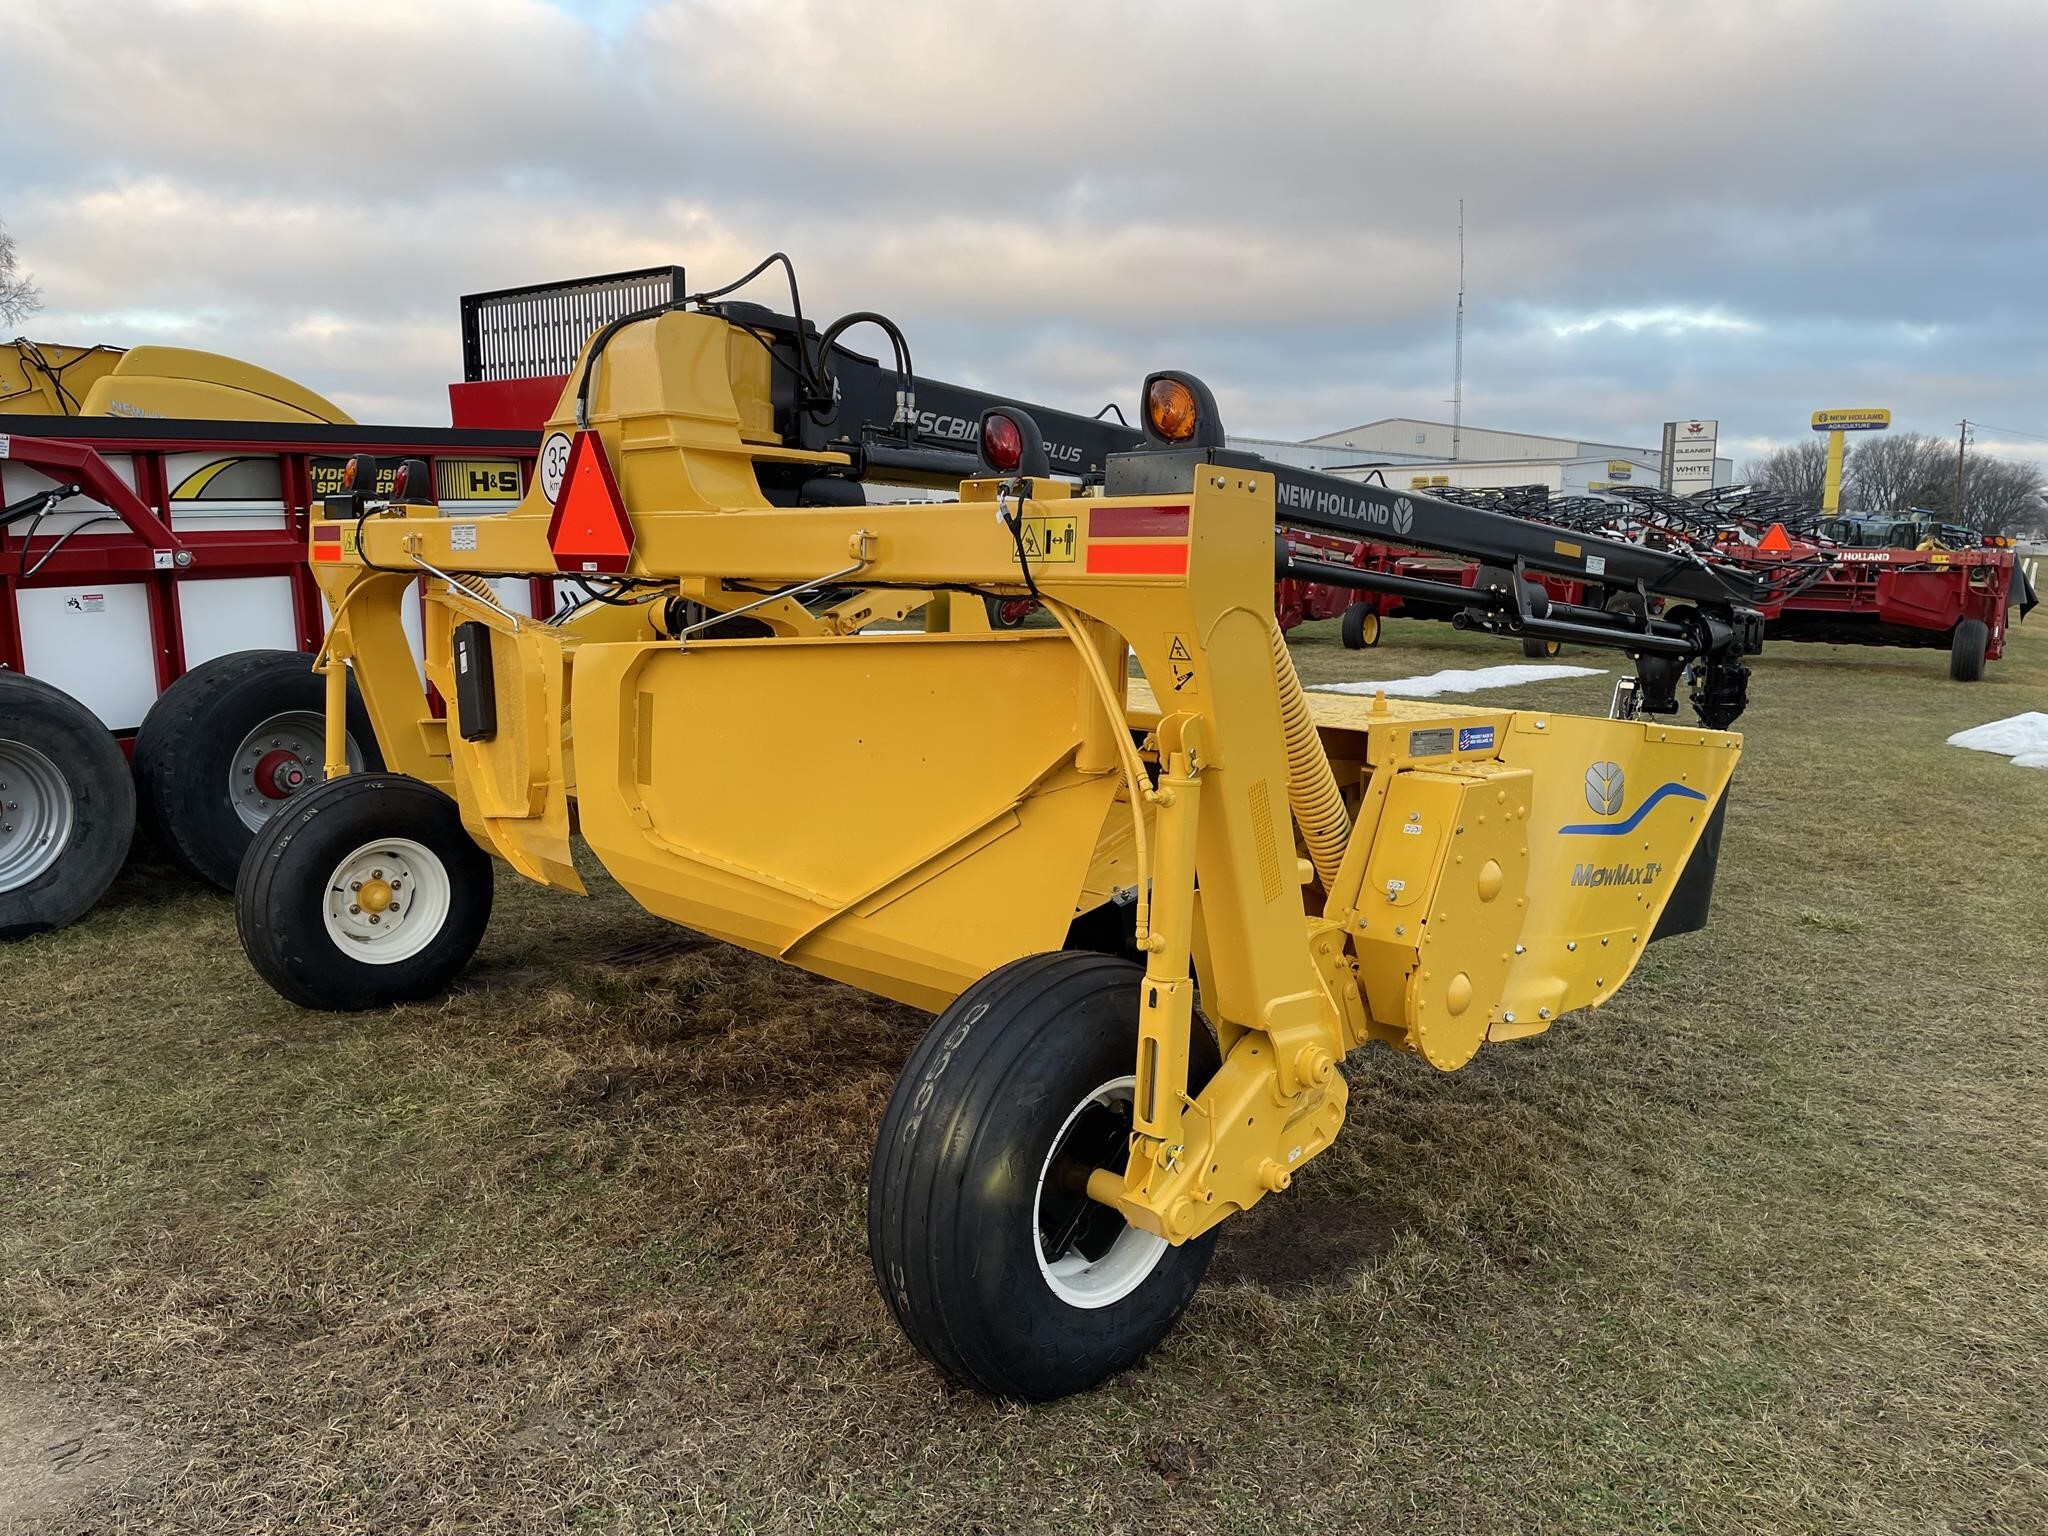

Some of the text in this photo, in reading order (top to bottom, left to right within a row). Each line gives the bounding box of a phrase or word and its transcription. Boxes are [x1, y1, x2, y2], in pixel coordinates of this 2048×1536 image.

[1848, 413, 1884, 421] HOLLAND
[548, 446, 567, 478] 35
[1676, 465, 1710, 473] WHITE
[469, 471, 518, 492] H&S
[1277, 482, 1390, 526] NEW HOLLAND
[1843, 552, 1889, 561] HOLLAND
